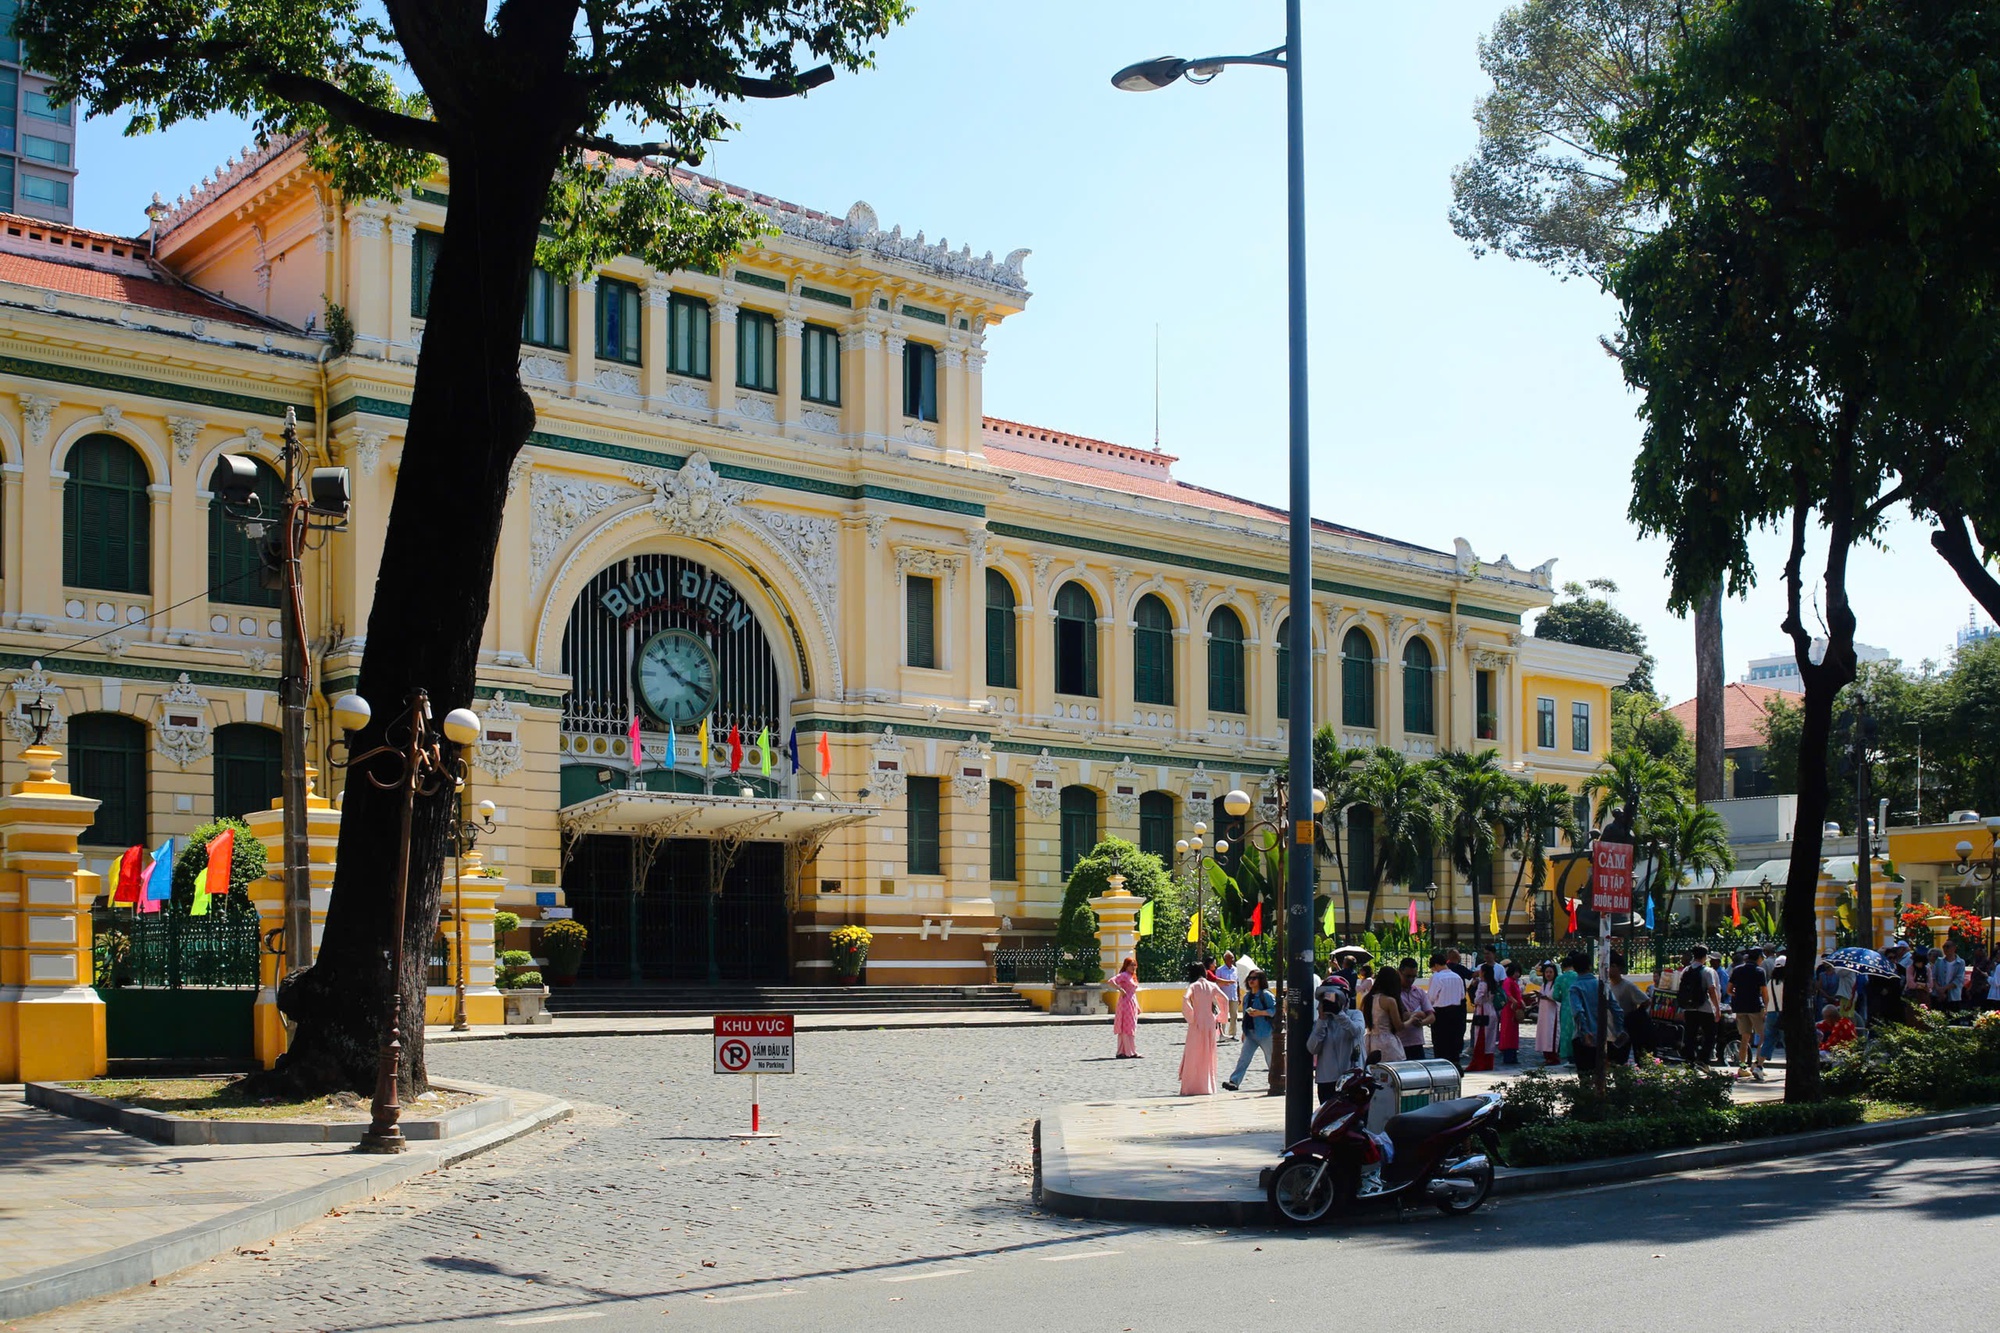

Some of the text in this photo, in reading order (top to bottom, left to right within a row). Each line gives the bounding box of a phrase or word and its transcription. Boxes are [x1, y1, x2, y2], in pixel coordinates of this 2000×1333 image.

[601, 568, 751, 632] BƯU ĐIỆN
[1598, 846, 1626, 869] CẤM
[1599, 873, 1625, 891] TỤ TẬP
[1613, 893, 1629, 909] BÁN
[723, 1019, 785, 1034] KHU VỰC
[752, 1041, 789, 1058] CẤM ĐẬU XE
[758, 1061, 785, 1069] No Parking
